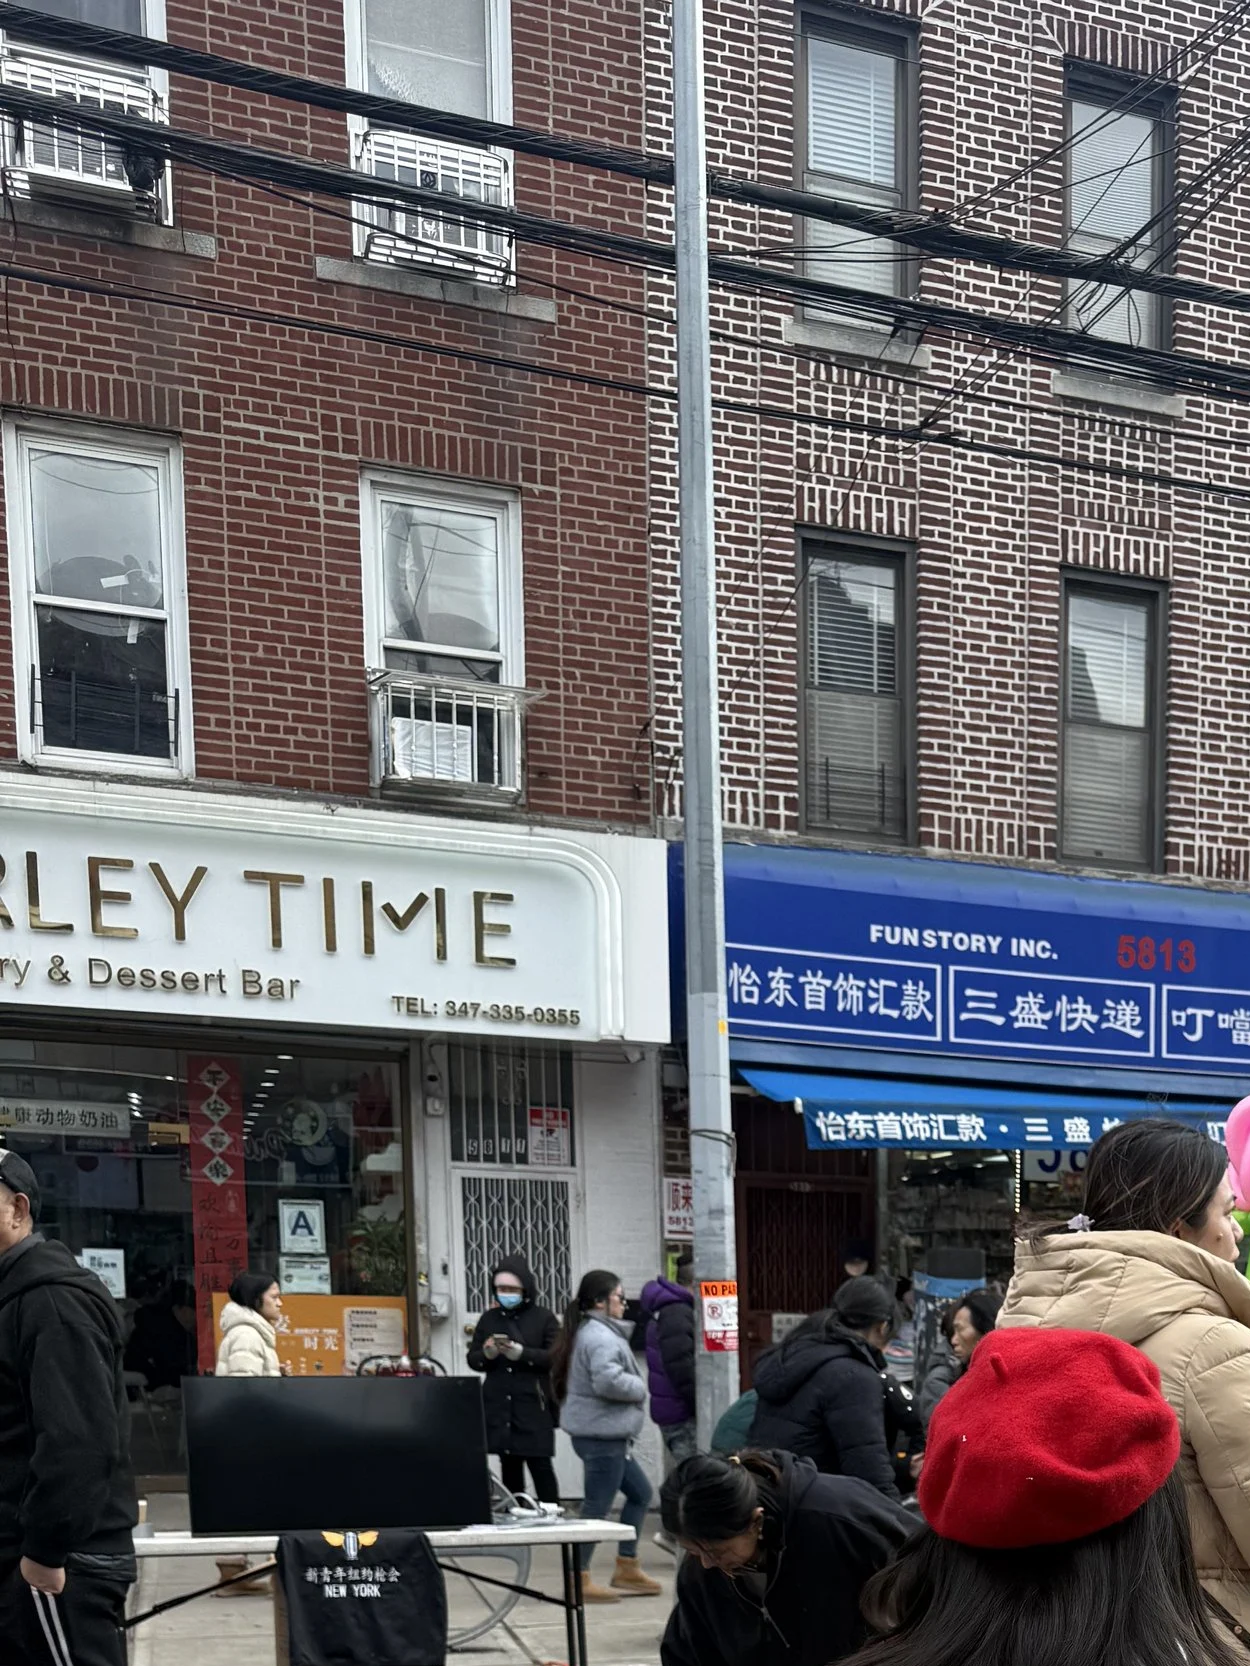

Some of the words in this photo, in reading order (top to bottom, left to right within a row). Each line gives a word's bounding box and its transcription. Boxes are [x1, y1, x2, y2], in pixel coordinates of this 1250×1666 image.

[0, 851, 208, 942] LEY
[243, 870, 516, 968] TIME
[1010, 937, 1058, 960] INC.
[1117, 934, 1196, 974] 5813
[47, 954, 72, 984] &
[88, 957, 227, 994] Dessert
[241, 968, 301, 999] Bar
[728, 962, 934, 1023] 怡东首饰汇款
[391, 995, 438, 1016] TEL:
[446, 1000, 580, 1026] 347-335-0355
[958, 986, 1145, 1040] 三盛快递
[815, 1110, 987, 1144] 怡东首饰汇款
[290, 1210, 315, 1237] A
[704, 1285, 717, 1296] NO
[324, 1583, 348, 1598] NEW
[352, 1583, 382, 1598] YORK
